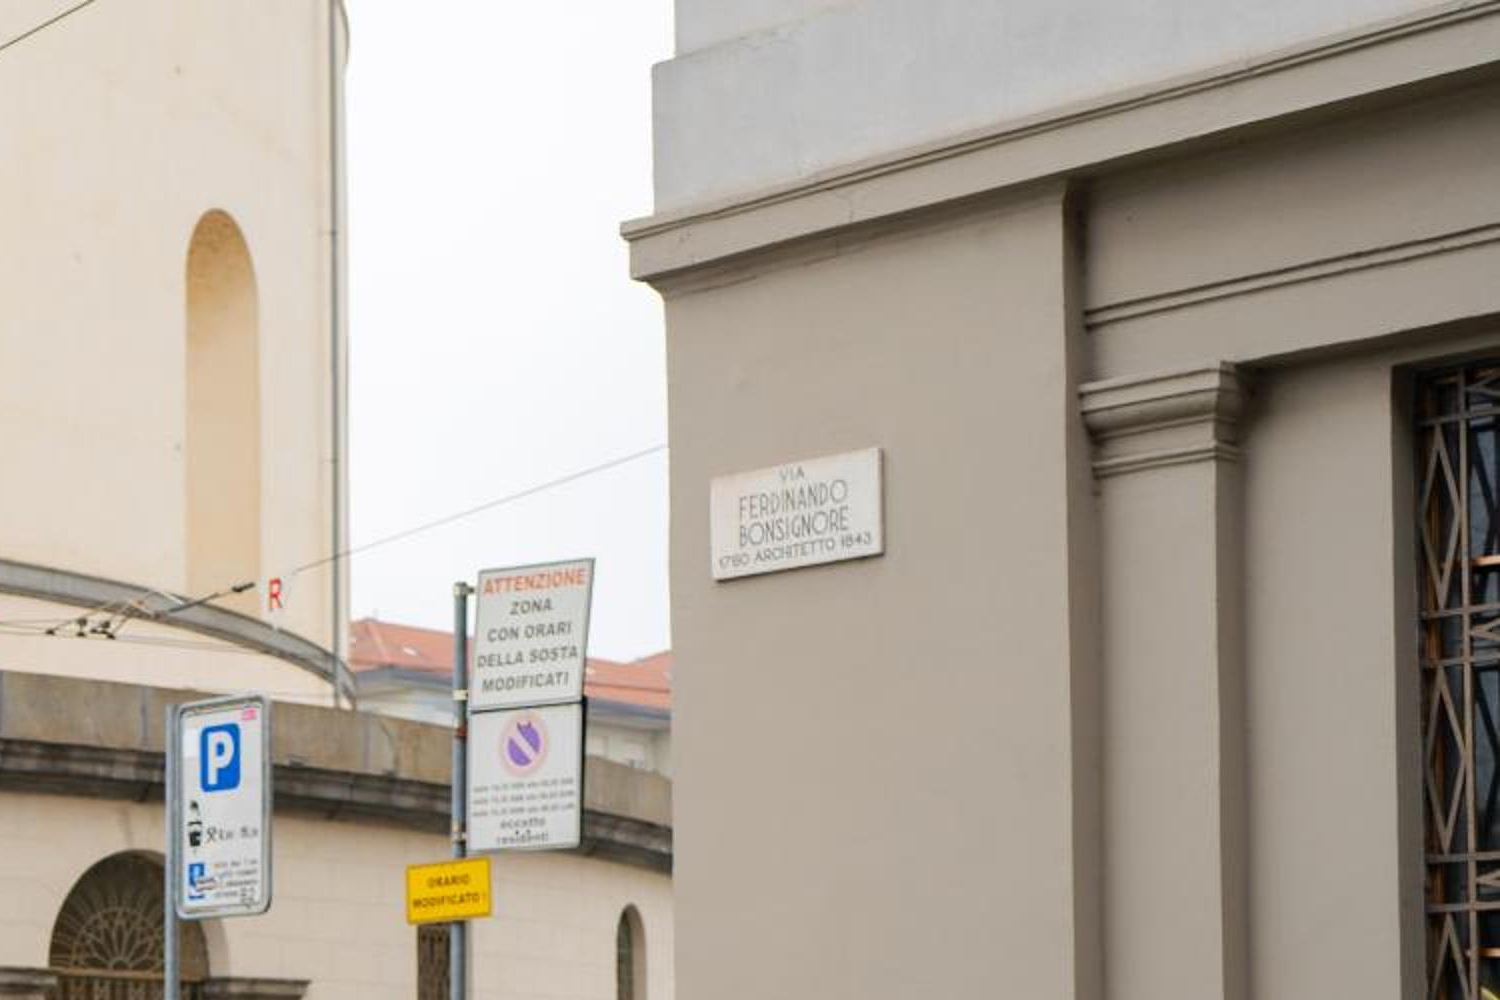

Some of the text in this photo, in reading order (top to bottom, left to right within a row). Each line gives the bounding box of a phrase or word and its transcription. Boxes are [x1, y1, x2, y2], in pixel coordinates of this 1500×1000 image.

[778, 465, 805, 481] VIA
[739, 479, 848, 520] FERDINANDO
[739, 505, 849, 547] BONSIGNORE
[754, 537, 835, 564] ARCHITETTO
[484, 567, 586, 594] ATTENZIONE
[269, 578, 283, 611] R
[509, 598, 552, 616] ZONA
[487, 621, 572, 642] CON ORARI
[477, 645, 578, 669] DELLA SOSTA
[482, 671, 569, 692] MODIFICATI
[207, 730, 235, 785] P
[427, 874, 470, 889] ORARIO
[412, 892, 481, 908] MODIFICATO
